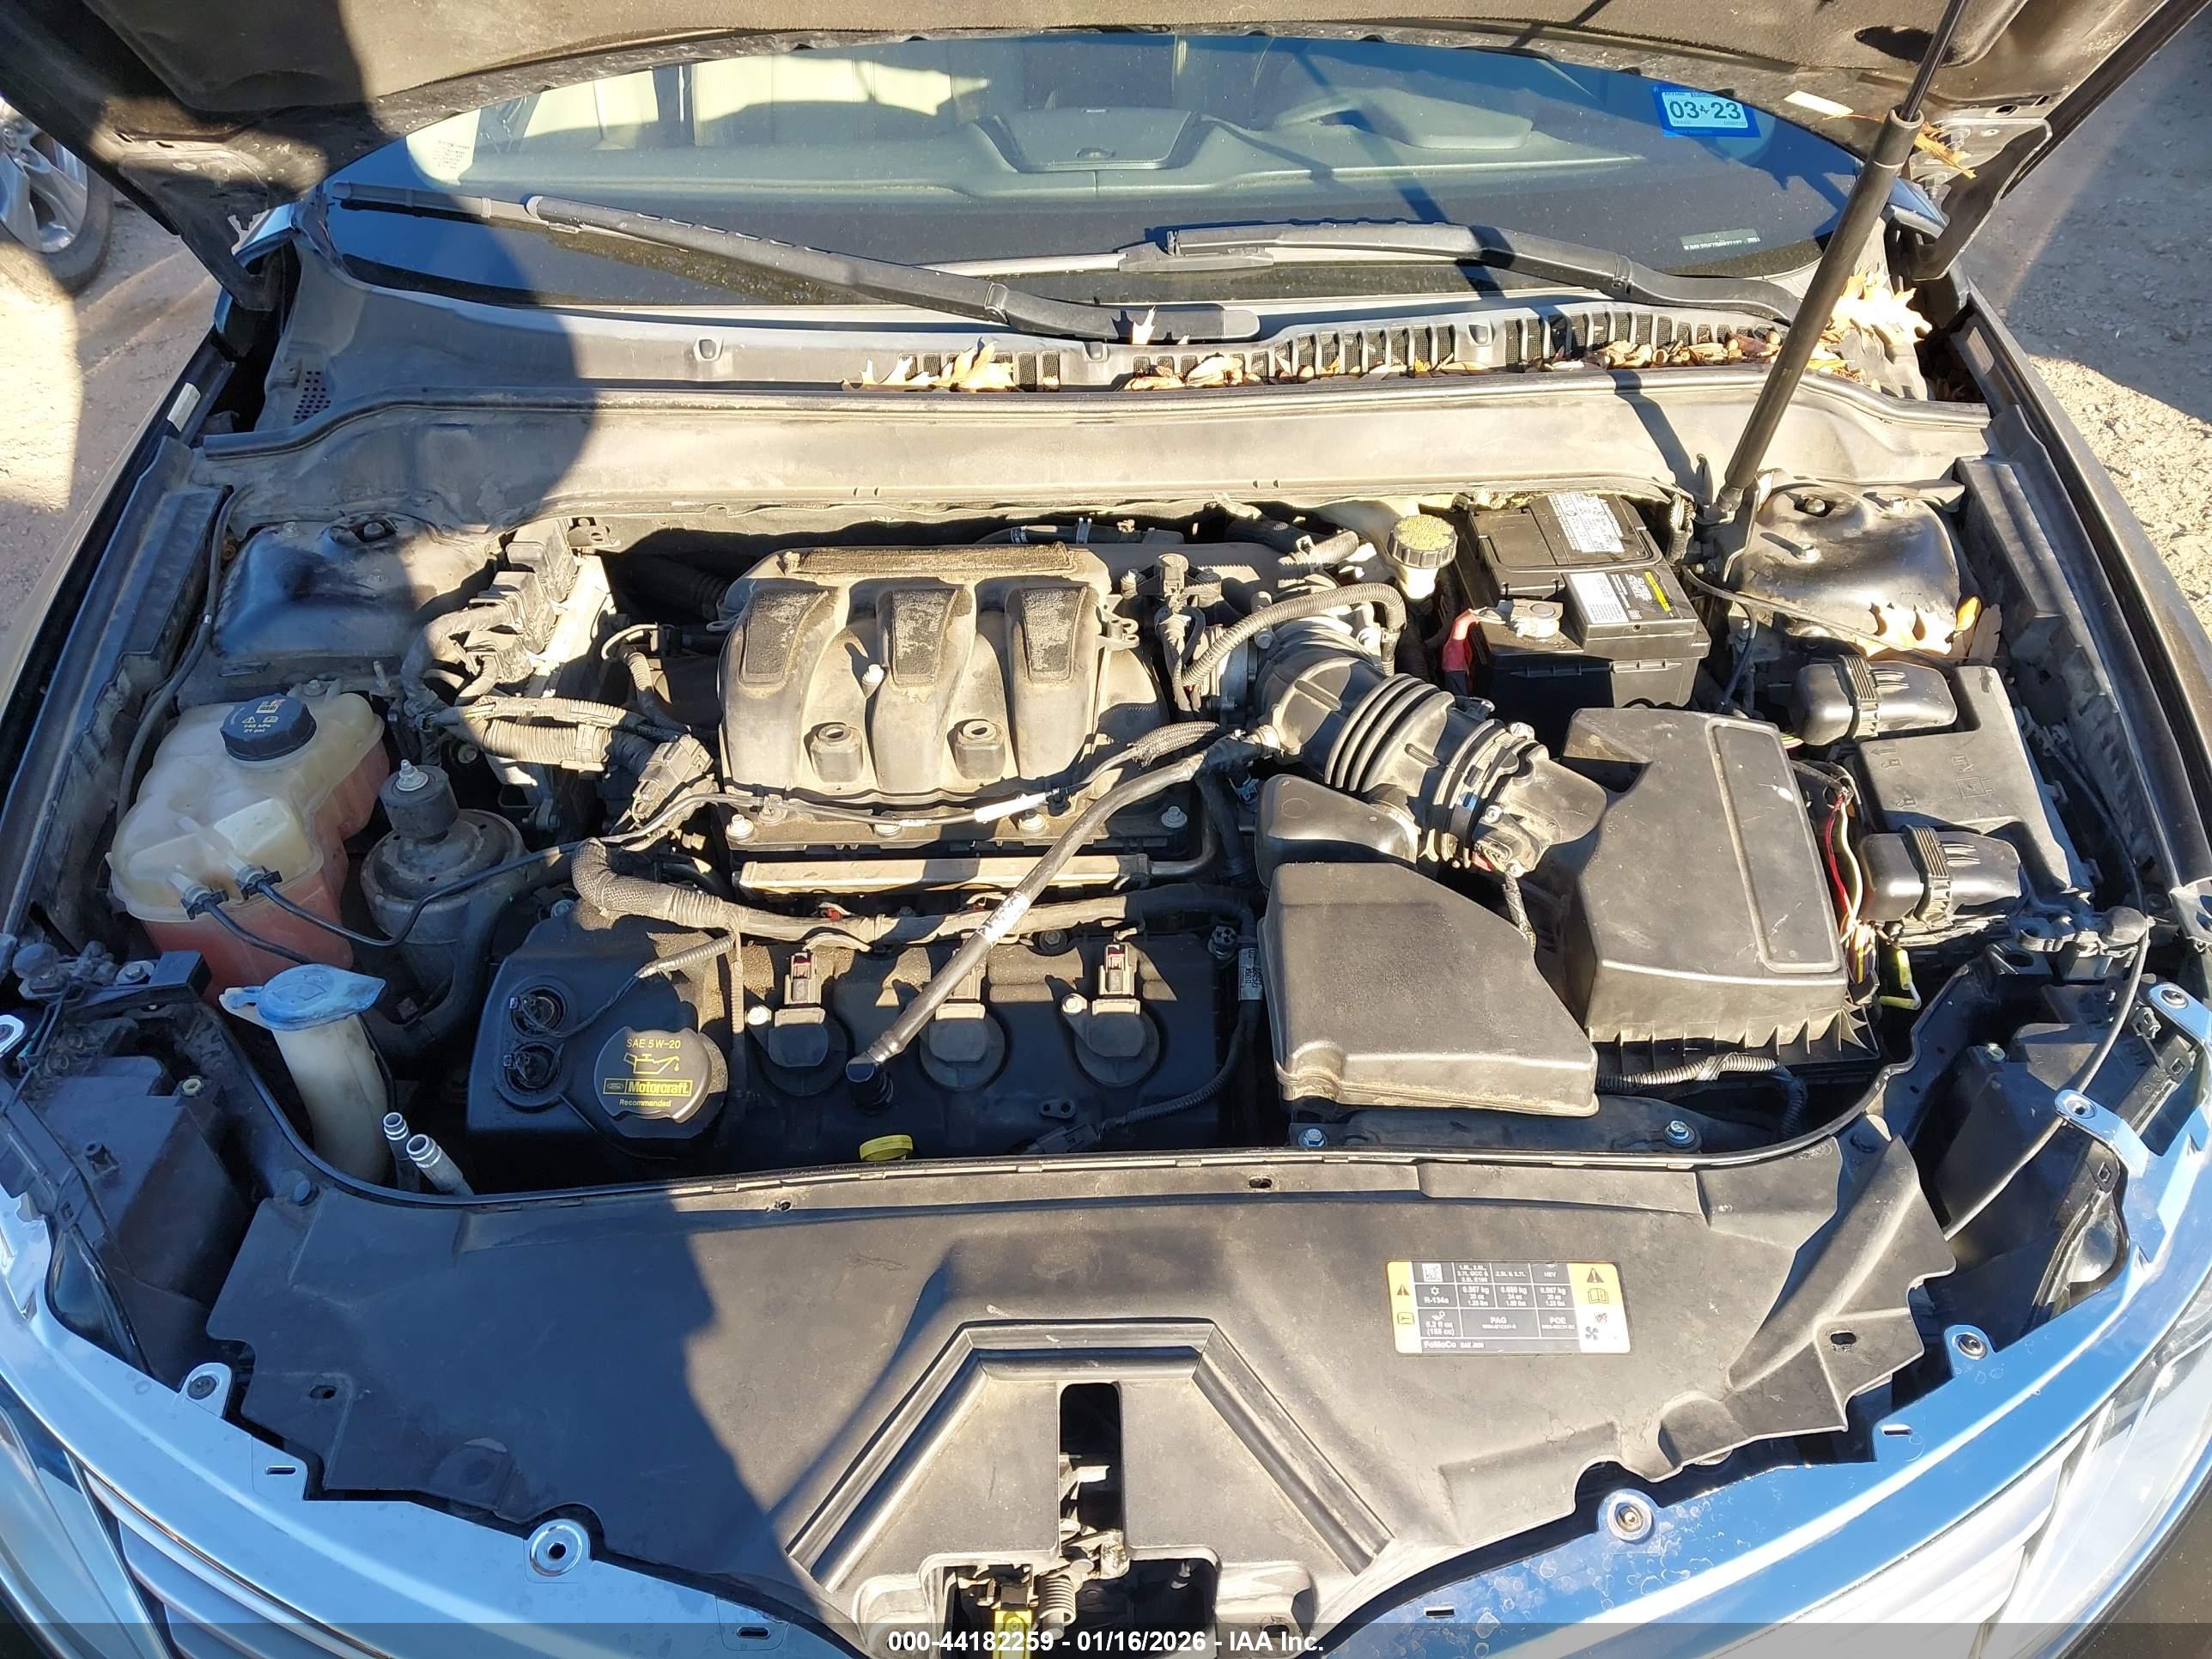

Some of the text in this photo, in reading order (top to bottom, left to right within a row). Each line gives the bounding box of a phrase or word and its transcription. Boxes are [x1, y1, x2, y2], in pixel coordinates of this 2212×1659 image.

[1669, 101, 1741, 118] 03 23
[626, 1038, 681, 1049] SAE 5W-20
[619, 1098, 672, 1108] Recommended
[1481, 1286, 1490, 1295] kg
[1519, 1286, 1527, 1295] kg
[1424, 1296, 1449, 1304] R-134a
